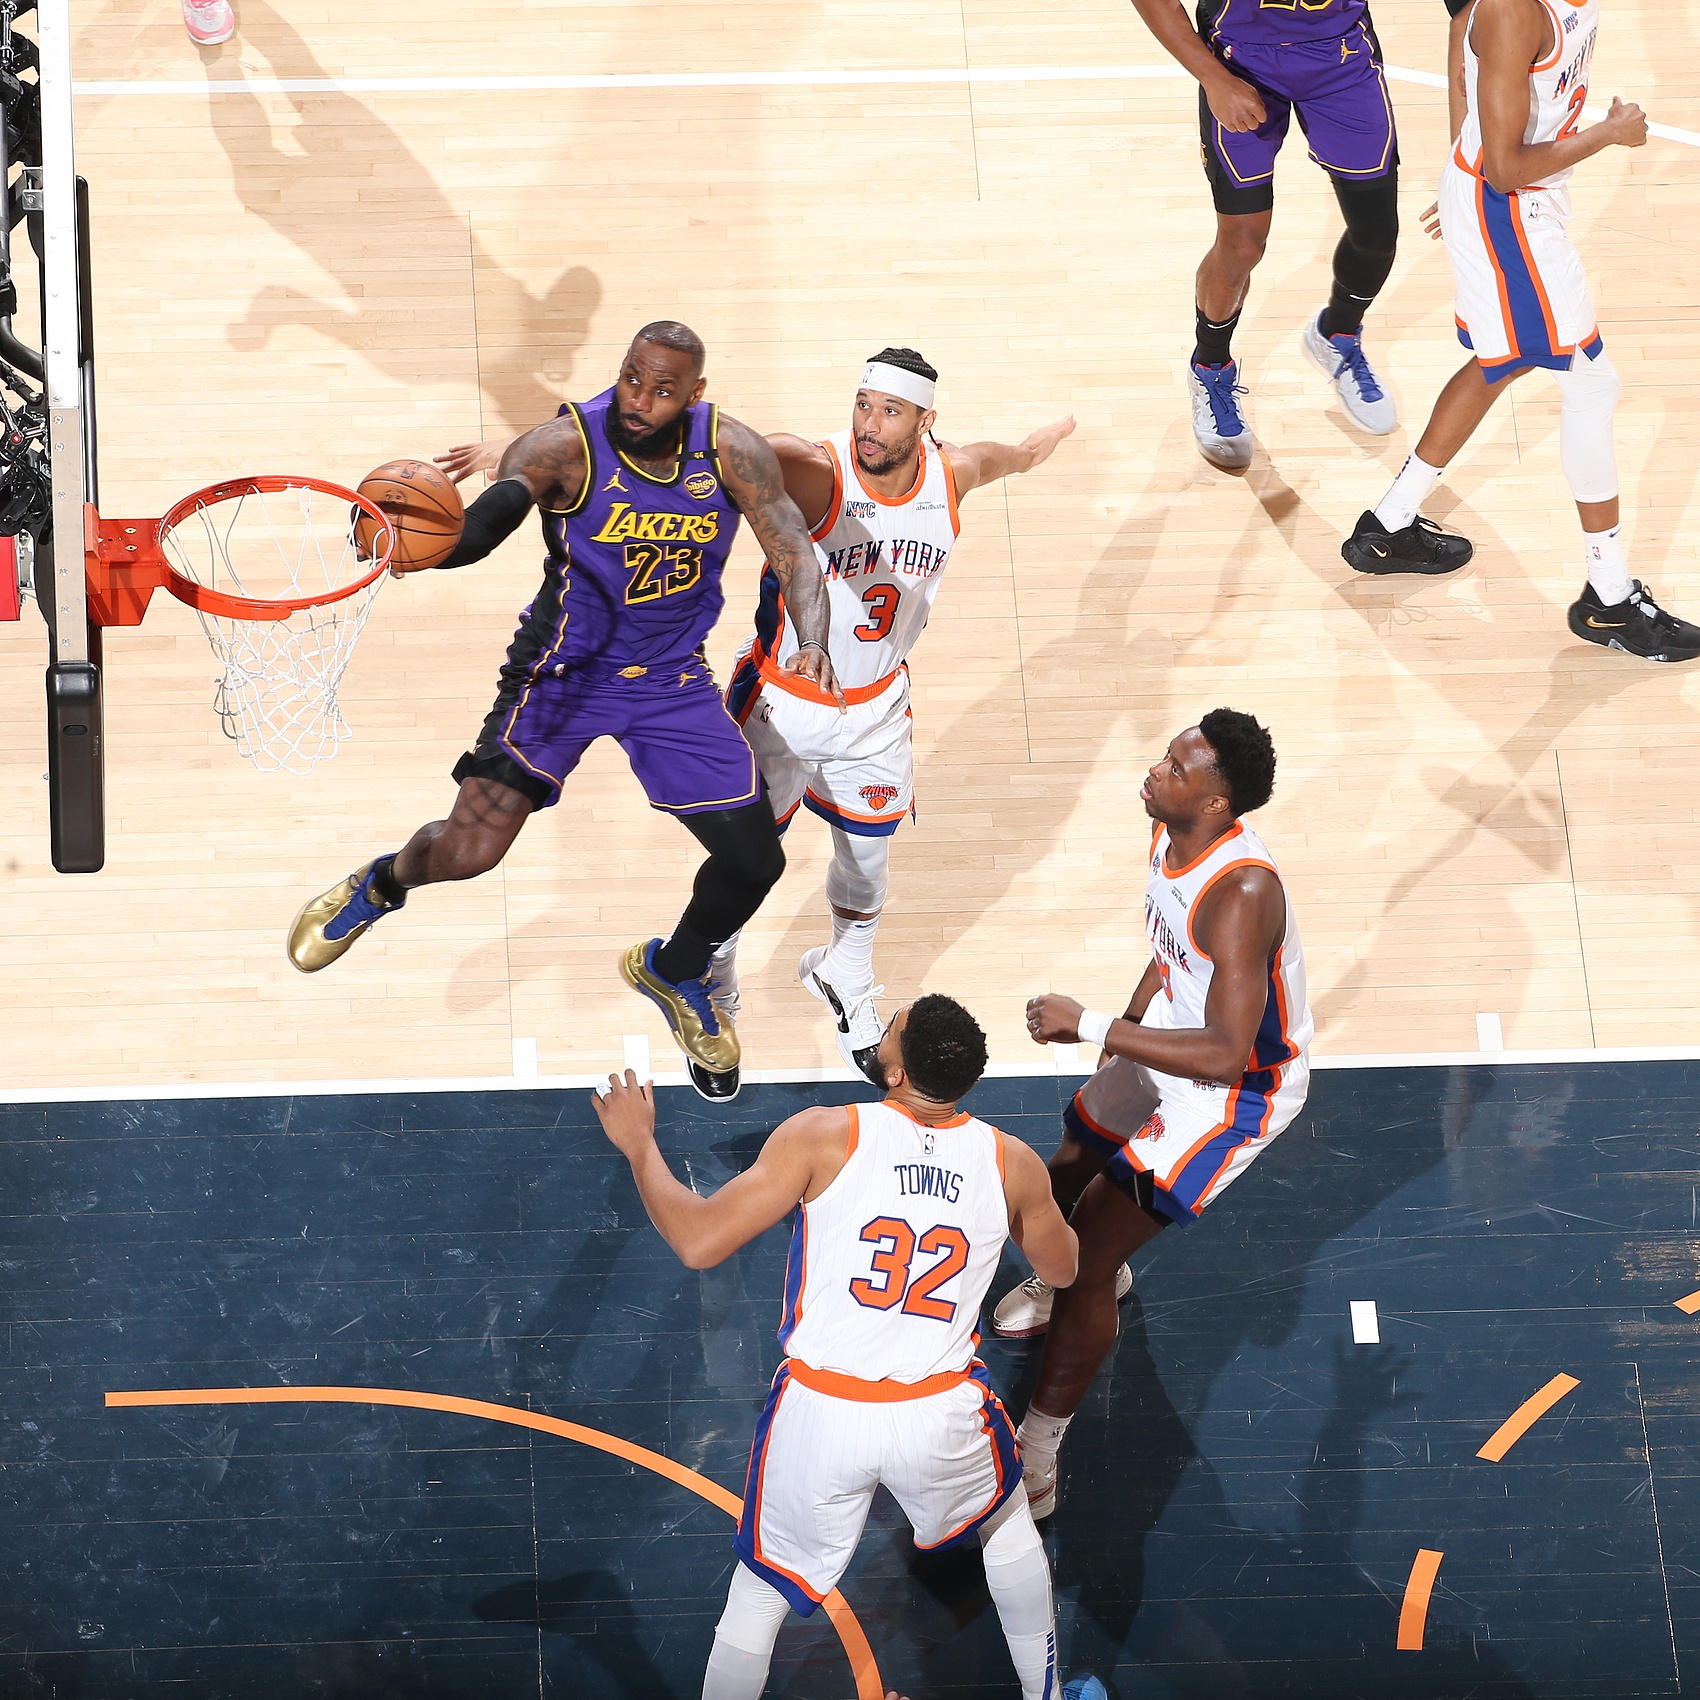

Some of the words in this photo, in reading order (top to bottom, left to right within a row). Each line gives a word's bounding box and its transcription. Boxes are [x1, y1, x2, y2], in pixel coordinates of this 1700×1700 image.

[590, 502, 719, 544] LAKERS
[846, 501, 876, 518] NYC
[624, 543, 704, 605] 23
[823, 540, 885, 582] NEW
[890, 539, 947, 578] YORK
[853, 583, 901, 642] 3
[894, 1164, 964, 1204] TOWNS
[849, 1215, 971, 1324] 32
